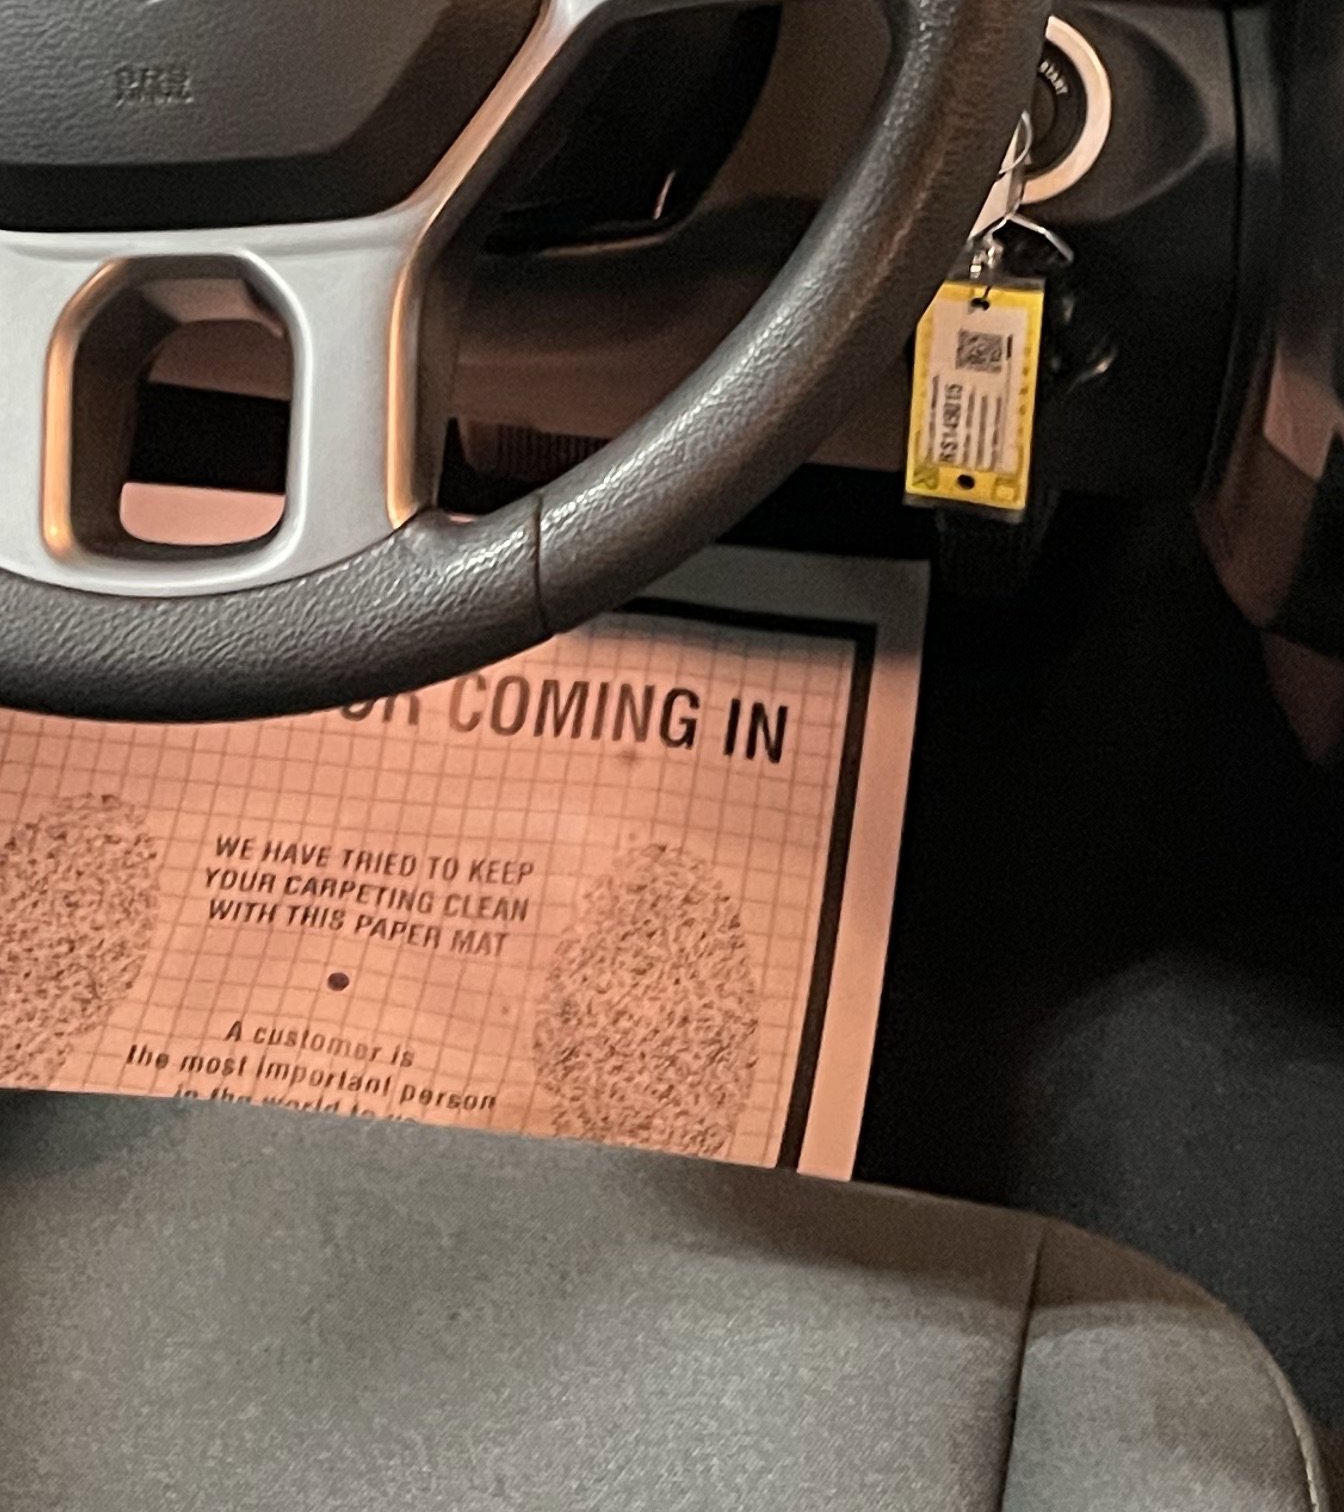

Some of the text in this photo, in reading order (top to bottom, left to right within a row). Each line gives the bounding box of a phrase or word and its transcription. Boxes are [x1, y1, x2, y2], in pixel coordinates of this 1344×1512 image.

[449, 674, 700, 750] COMING
[722, 698, 788, 764] IN
[216, 834, 534, 885] WE HAVE TRIED TO KEEP
[205, 867, 529, 922] YOUR CARPETING CLEAN
[208, 899, 509, 957] WITH THIS PAPER MAT
[226, 1020, 414, 1068] A customer is
[126, 1044, 497, 1111] the most important person
